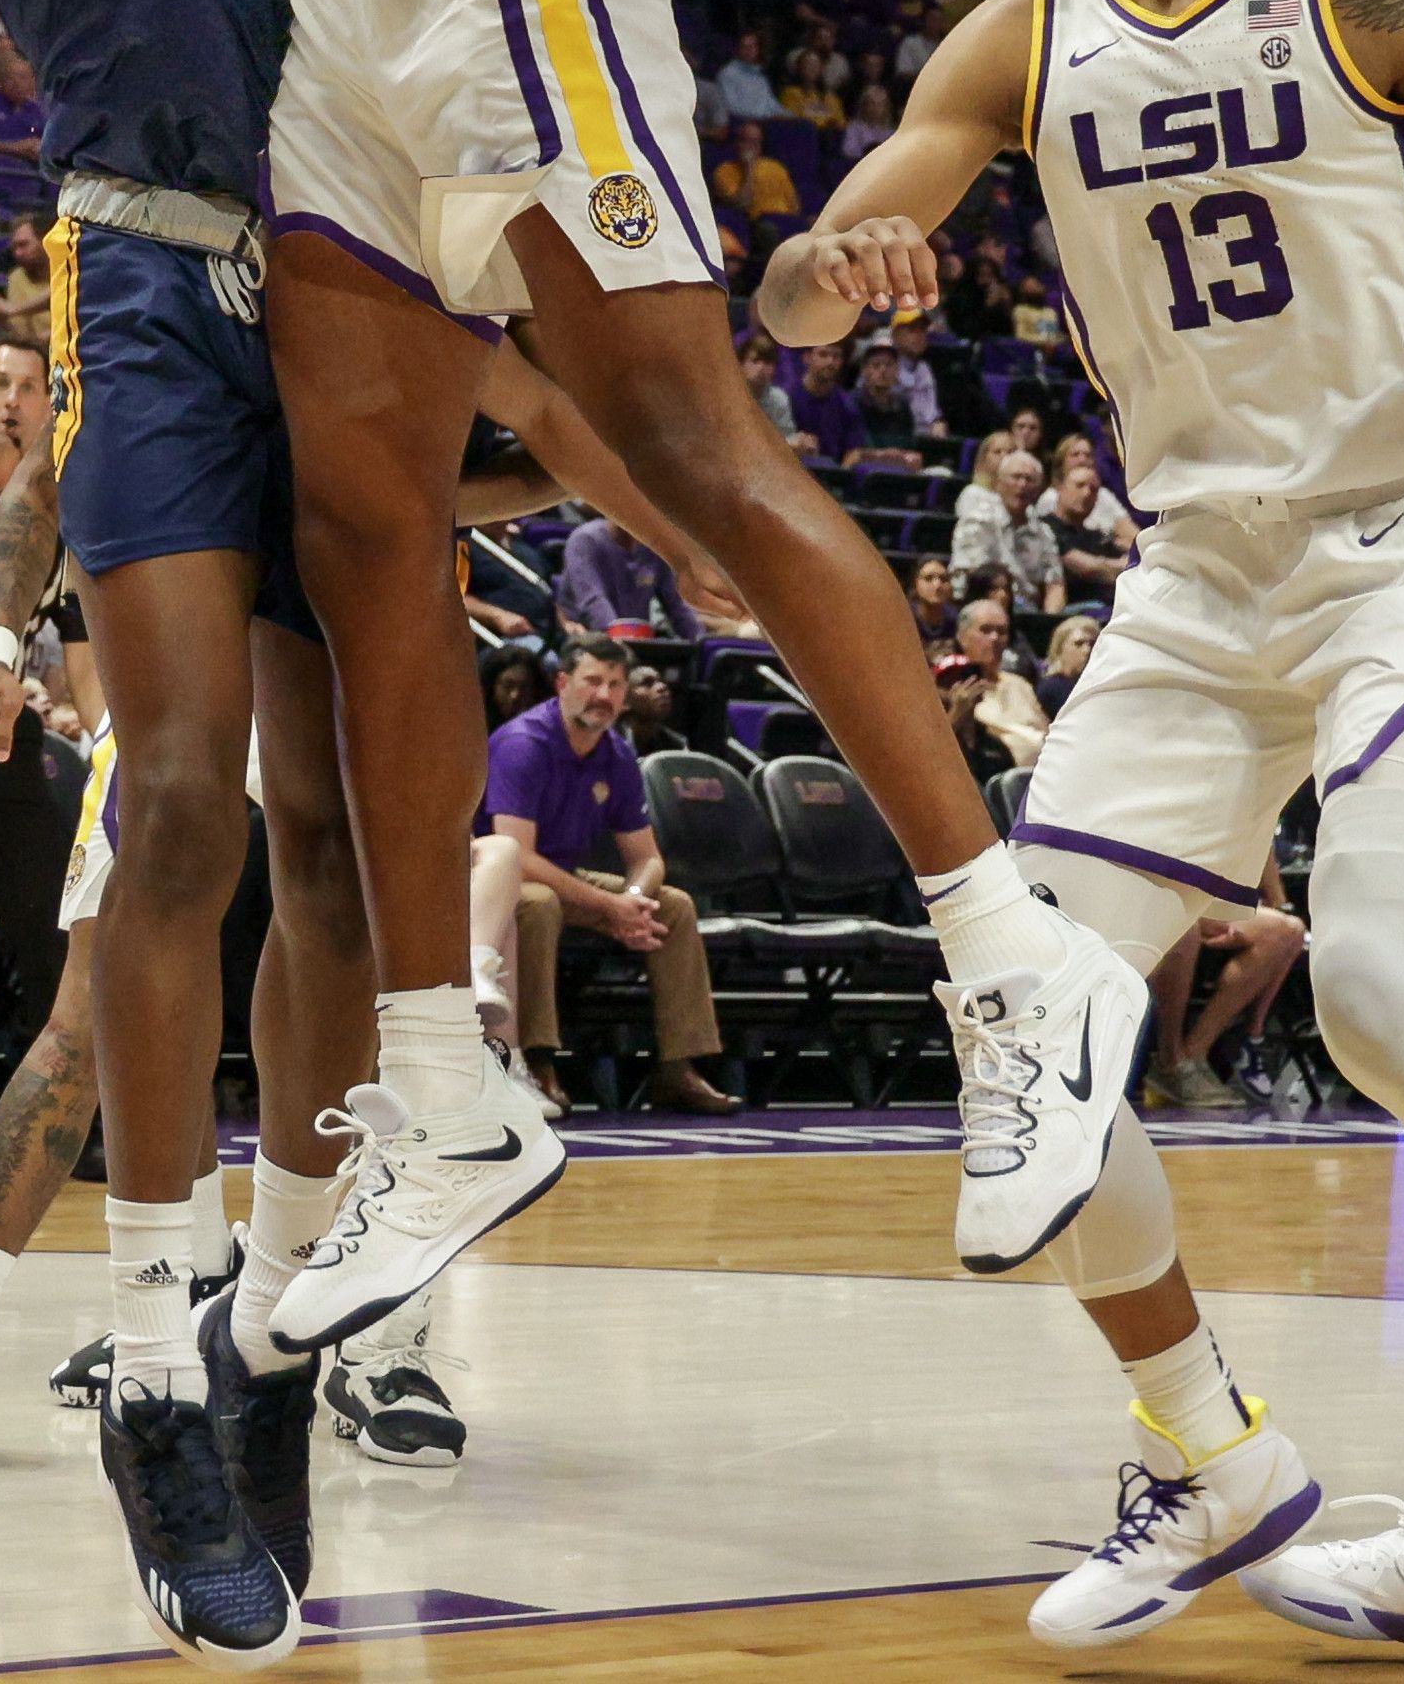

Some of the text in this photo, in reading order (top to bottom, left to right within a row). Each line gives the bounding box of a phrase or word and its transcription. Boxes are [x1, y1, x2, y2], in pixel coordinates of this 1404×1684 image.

[1261, 37, 1291, 69] SEC
[1069, 80, 1308, 191] LSU
[1145, 190, 1295, 332] 13
[135, 1273, 180, 1285] adidas
